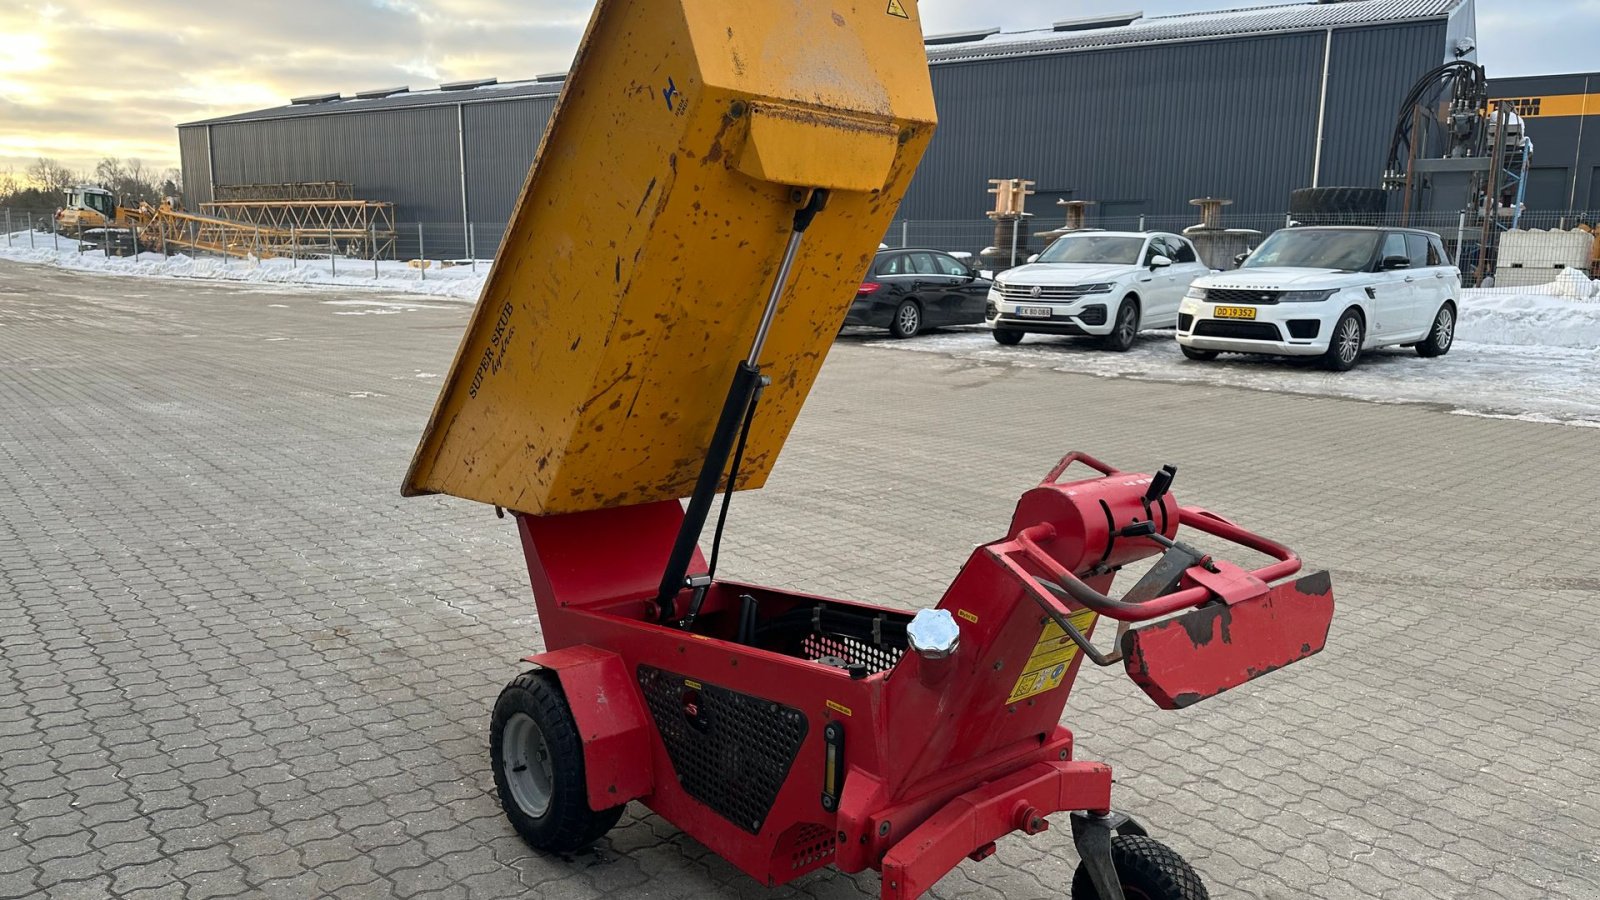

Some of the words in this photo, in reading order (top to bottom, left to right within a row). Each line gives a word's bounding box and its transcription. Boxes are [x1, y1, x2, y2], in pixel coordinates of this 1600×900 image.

[1217, 307, 1227, 315] DD
[1229, 308, 1238, 316] 19
[1238, 309, 1252, 317] 352
[469, 347, 495, 400] SUPER
[491, 301, 514, 347] SKUB
